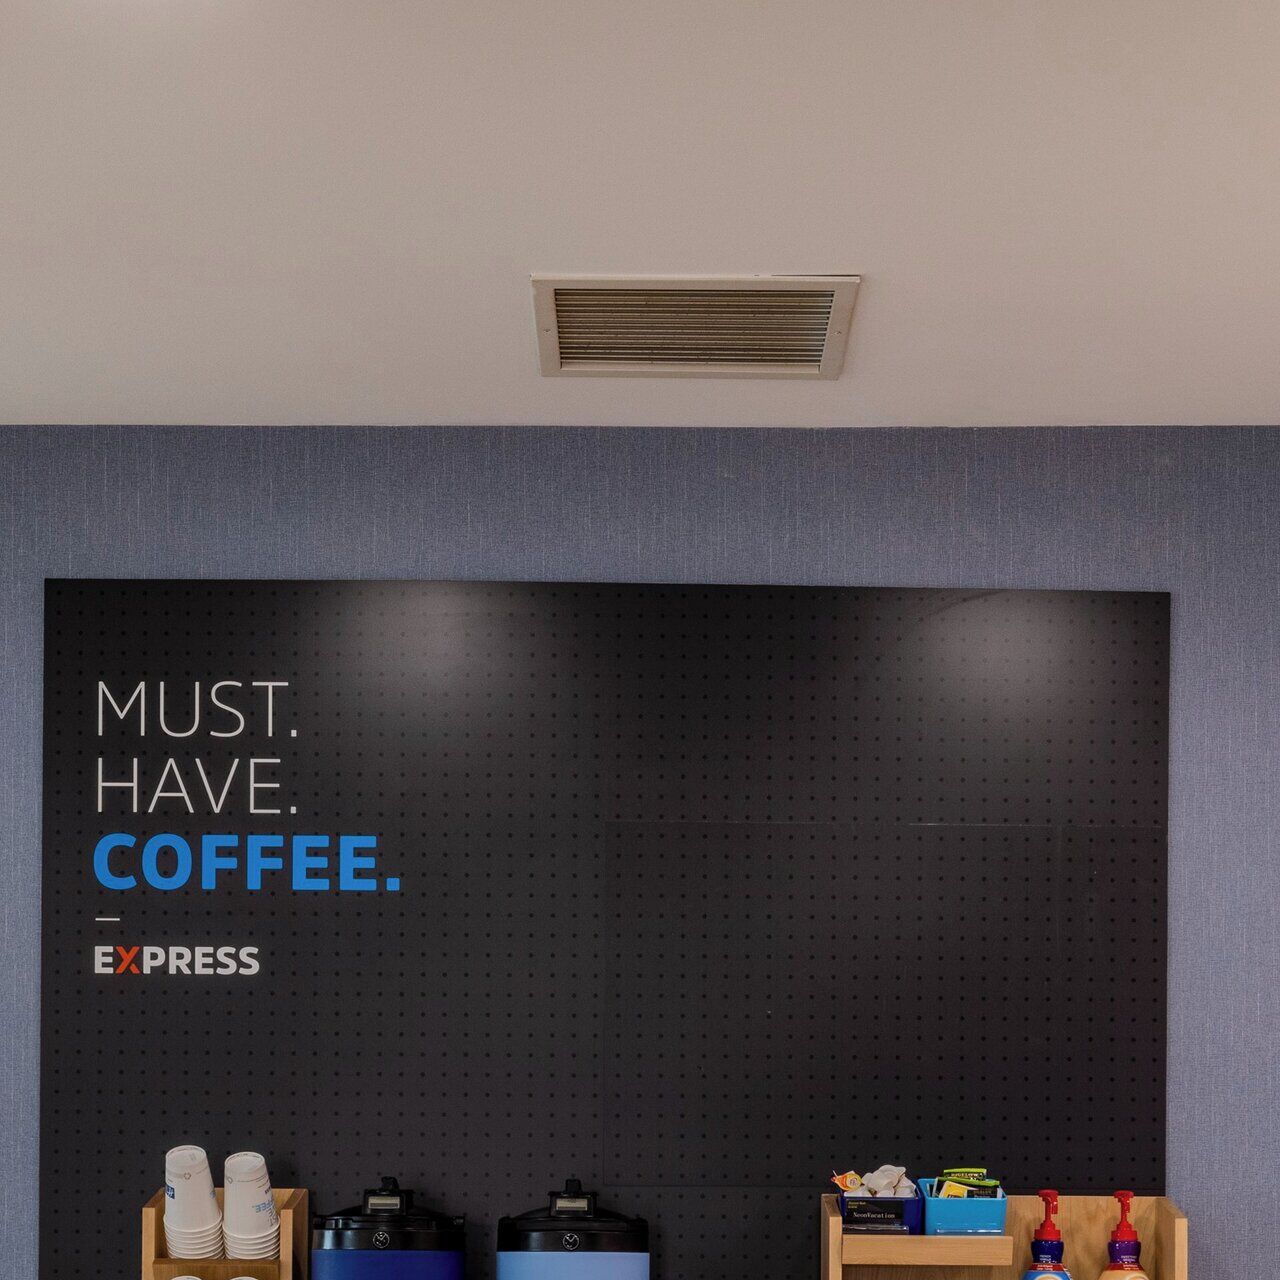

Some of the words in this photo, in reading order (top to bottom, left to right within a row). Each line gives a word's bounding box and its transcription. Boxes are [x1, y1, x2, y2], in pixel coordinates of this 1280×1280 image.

[97, 680, 297, 737] MUST.
[97, 757, 297, 814] HAVE.
[93, 832, 400, 891] COFFEE.
[94, 945, 260, 975] EXPRESS
